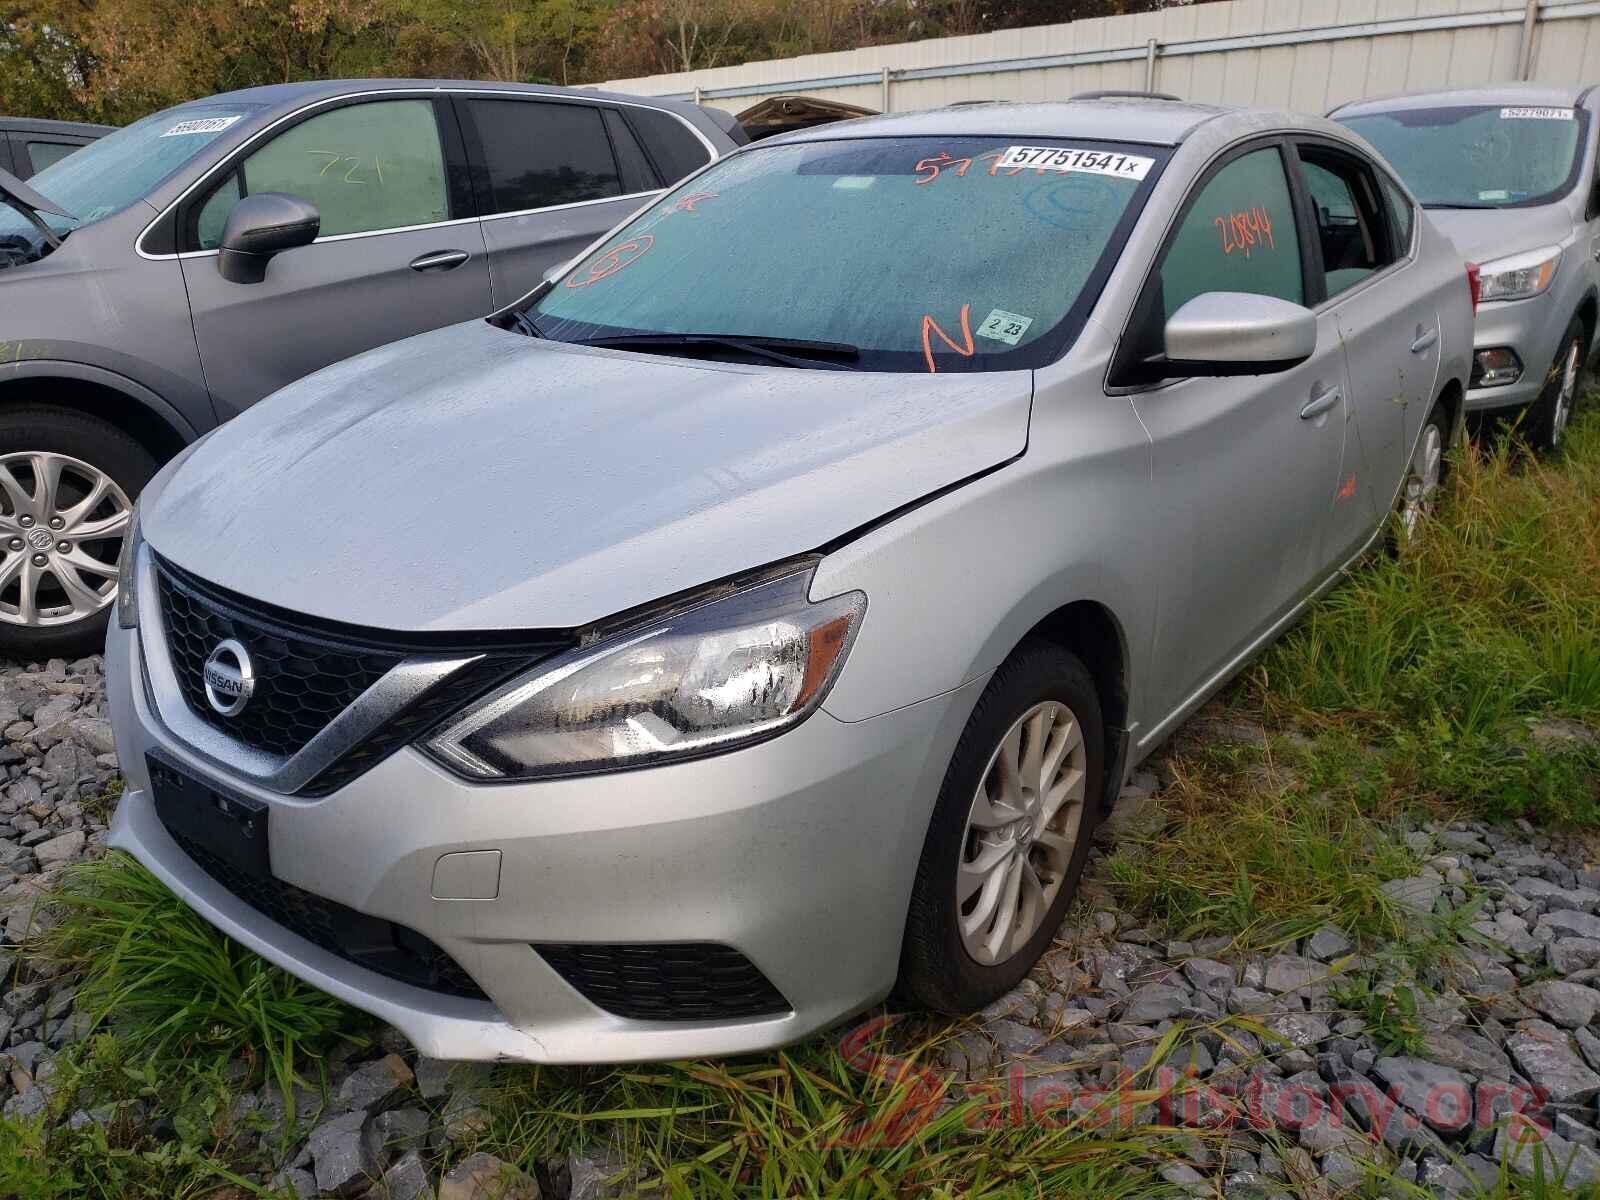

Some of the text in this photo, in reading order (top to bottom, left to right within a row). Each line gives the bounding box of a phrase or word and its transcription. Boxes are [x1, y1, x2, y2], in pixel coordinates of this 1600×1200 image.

[305, 149, 384, 184] 721
[922, 303, 975, 373] N
[1003, 322, 1022, 335] 23
[205, 668, 243, 693] NISSAN
